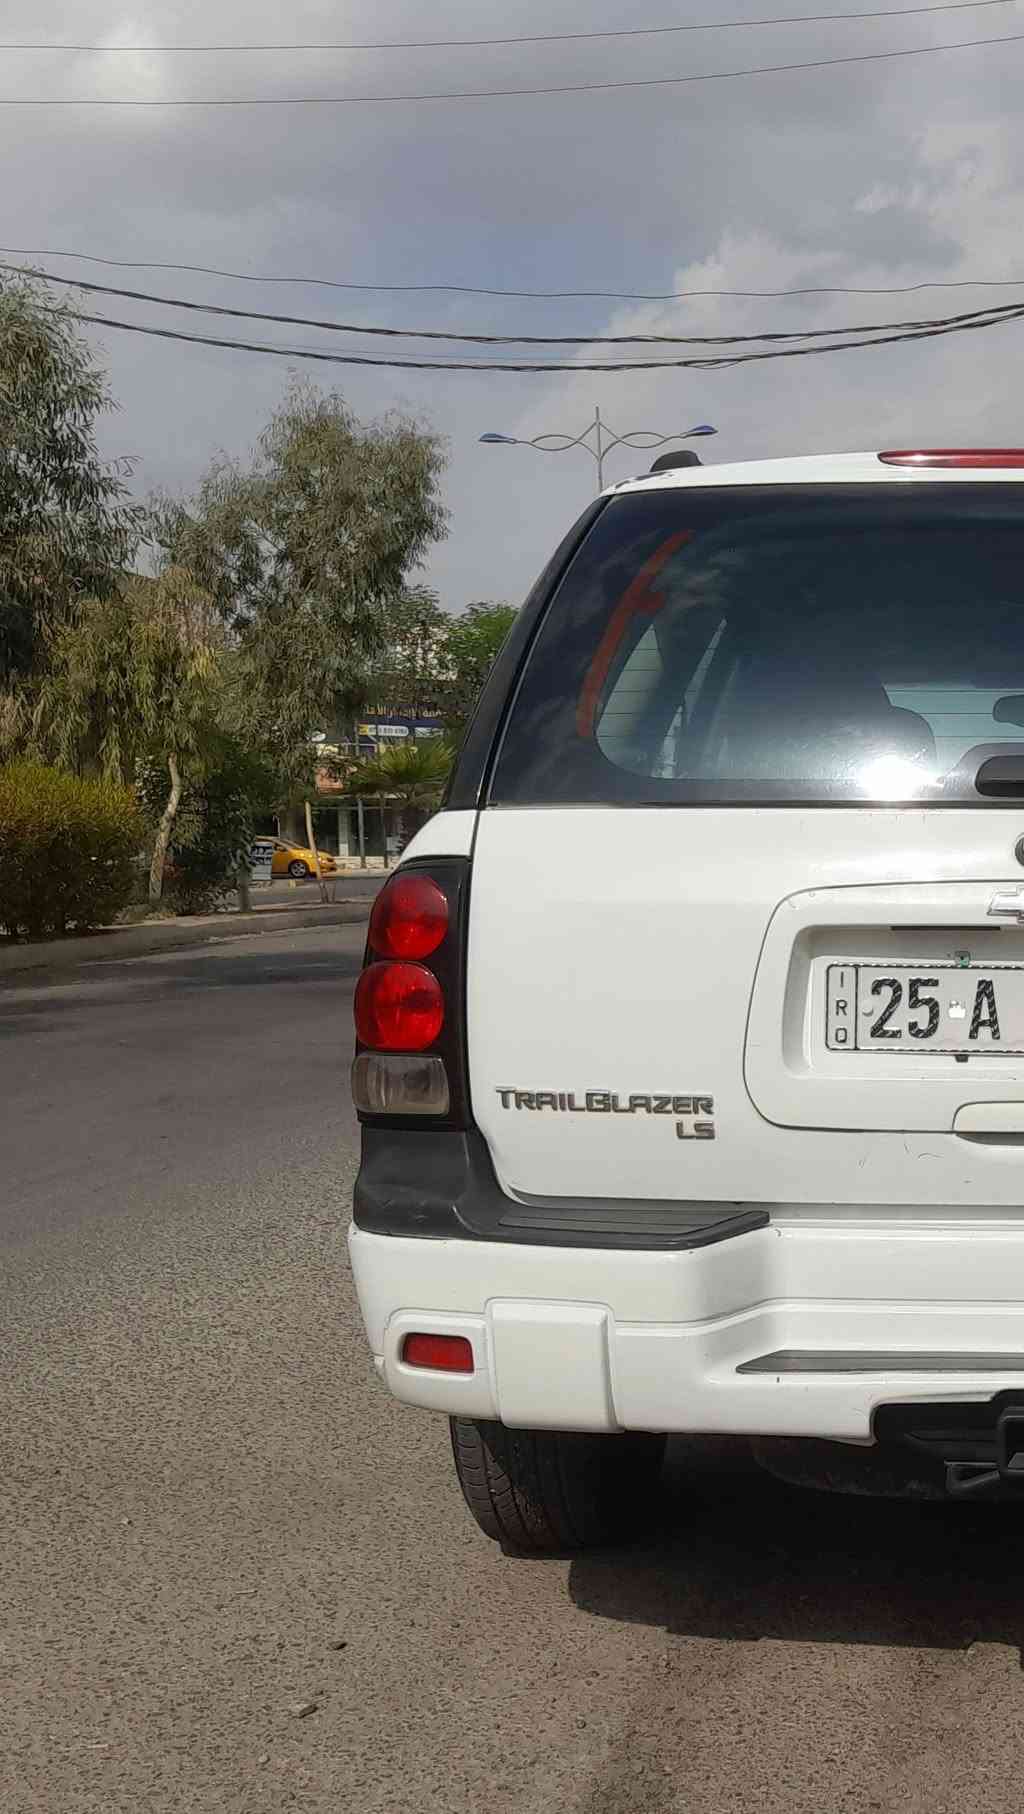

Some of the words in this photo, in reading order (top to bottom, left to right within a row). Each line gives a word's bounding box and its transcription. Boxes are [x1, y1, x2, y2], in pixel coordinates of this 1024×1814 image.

[870, 978, 939, 1039] 25
[968, 979, 1000, 1040] A
[676, 1121, 715, 1139] LS
